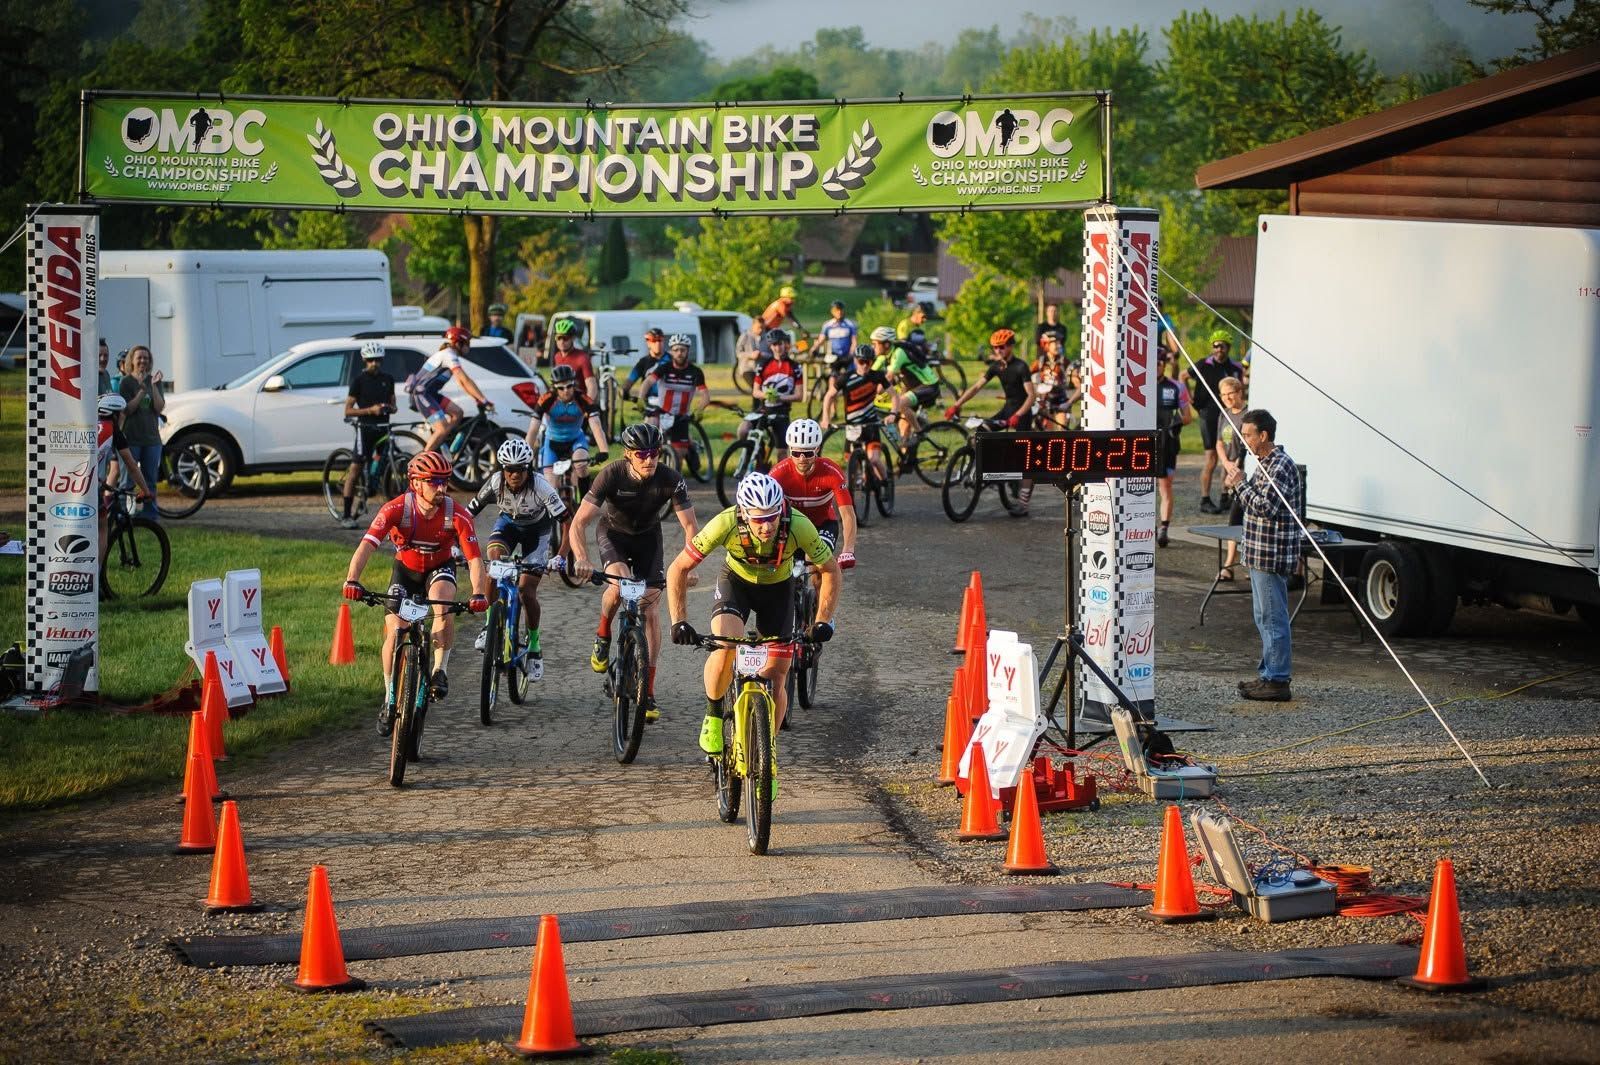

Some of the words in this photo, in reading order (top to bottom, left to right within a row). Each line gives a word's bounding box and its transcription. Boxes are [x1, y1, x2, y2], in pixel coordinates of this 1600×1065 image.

[121, 107, 267, 156] OMBC
[372, 112, 479, 148] OHIO
[492, 115, 708, 150] MOUNTAIN
[723, 113, 818, 148] BIKE
[926, 108, 1074, 158] OMBC
[124, 154, 157, 166] OHIO
[161, 156, 227, 168] MOUNTAIN
[231, 158, 260, 169] BIKE
[931, 160, 964, 171] OHIO
[969, 159, 1036, 170] MOUNTAIN
[1040, 157, 1069, 168] BIKE
[122, 165, 259, 182] CHAMPIONSHIP
[368, 150, 815, 199] CHAMPIONSHIP
[930, 169, 1069, 186] CHAMPIONSHIP
[147, 181, 232, 192] WWW.OMBC.NET
[957, 185, 1042, 195] WWW.OMBC.NET
[86, 233, 96, 265] TUBES
[86, 266, 96, 288] AND
[86, 288, 96, 317] TIRES
[47, 226, 82, 401] KENDA
[1090, 233, 1110, 407] KENDA
[1126, 233, 1151, 407] KENDA
[49, 431, 73, 444] GREAT
[74, 431, 96, 444] LAKES
[55, 506, 90, 516] KMC
[51, 573, 90, 583] DARN
[50, 583, 89, 591] TOUGH
[46, 627, 96, 641] Velocity
[744, 656, 761, 666] 506
